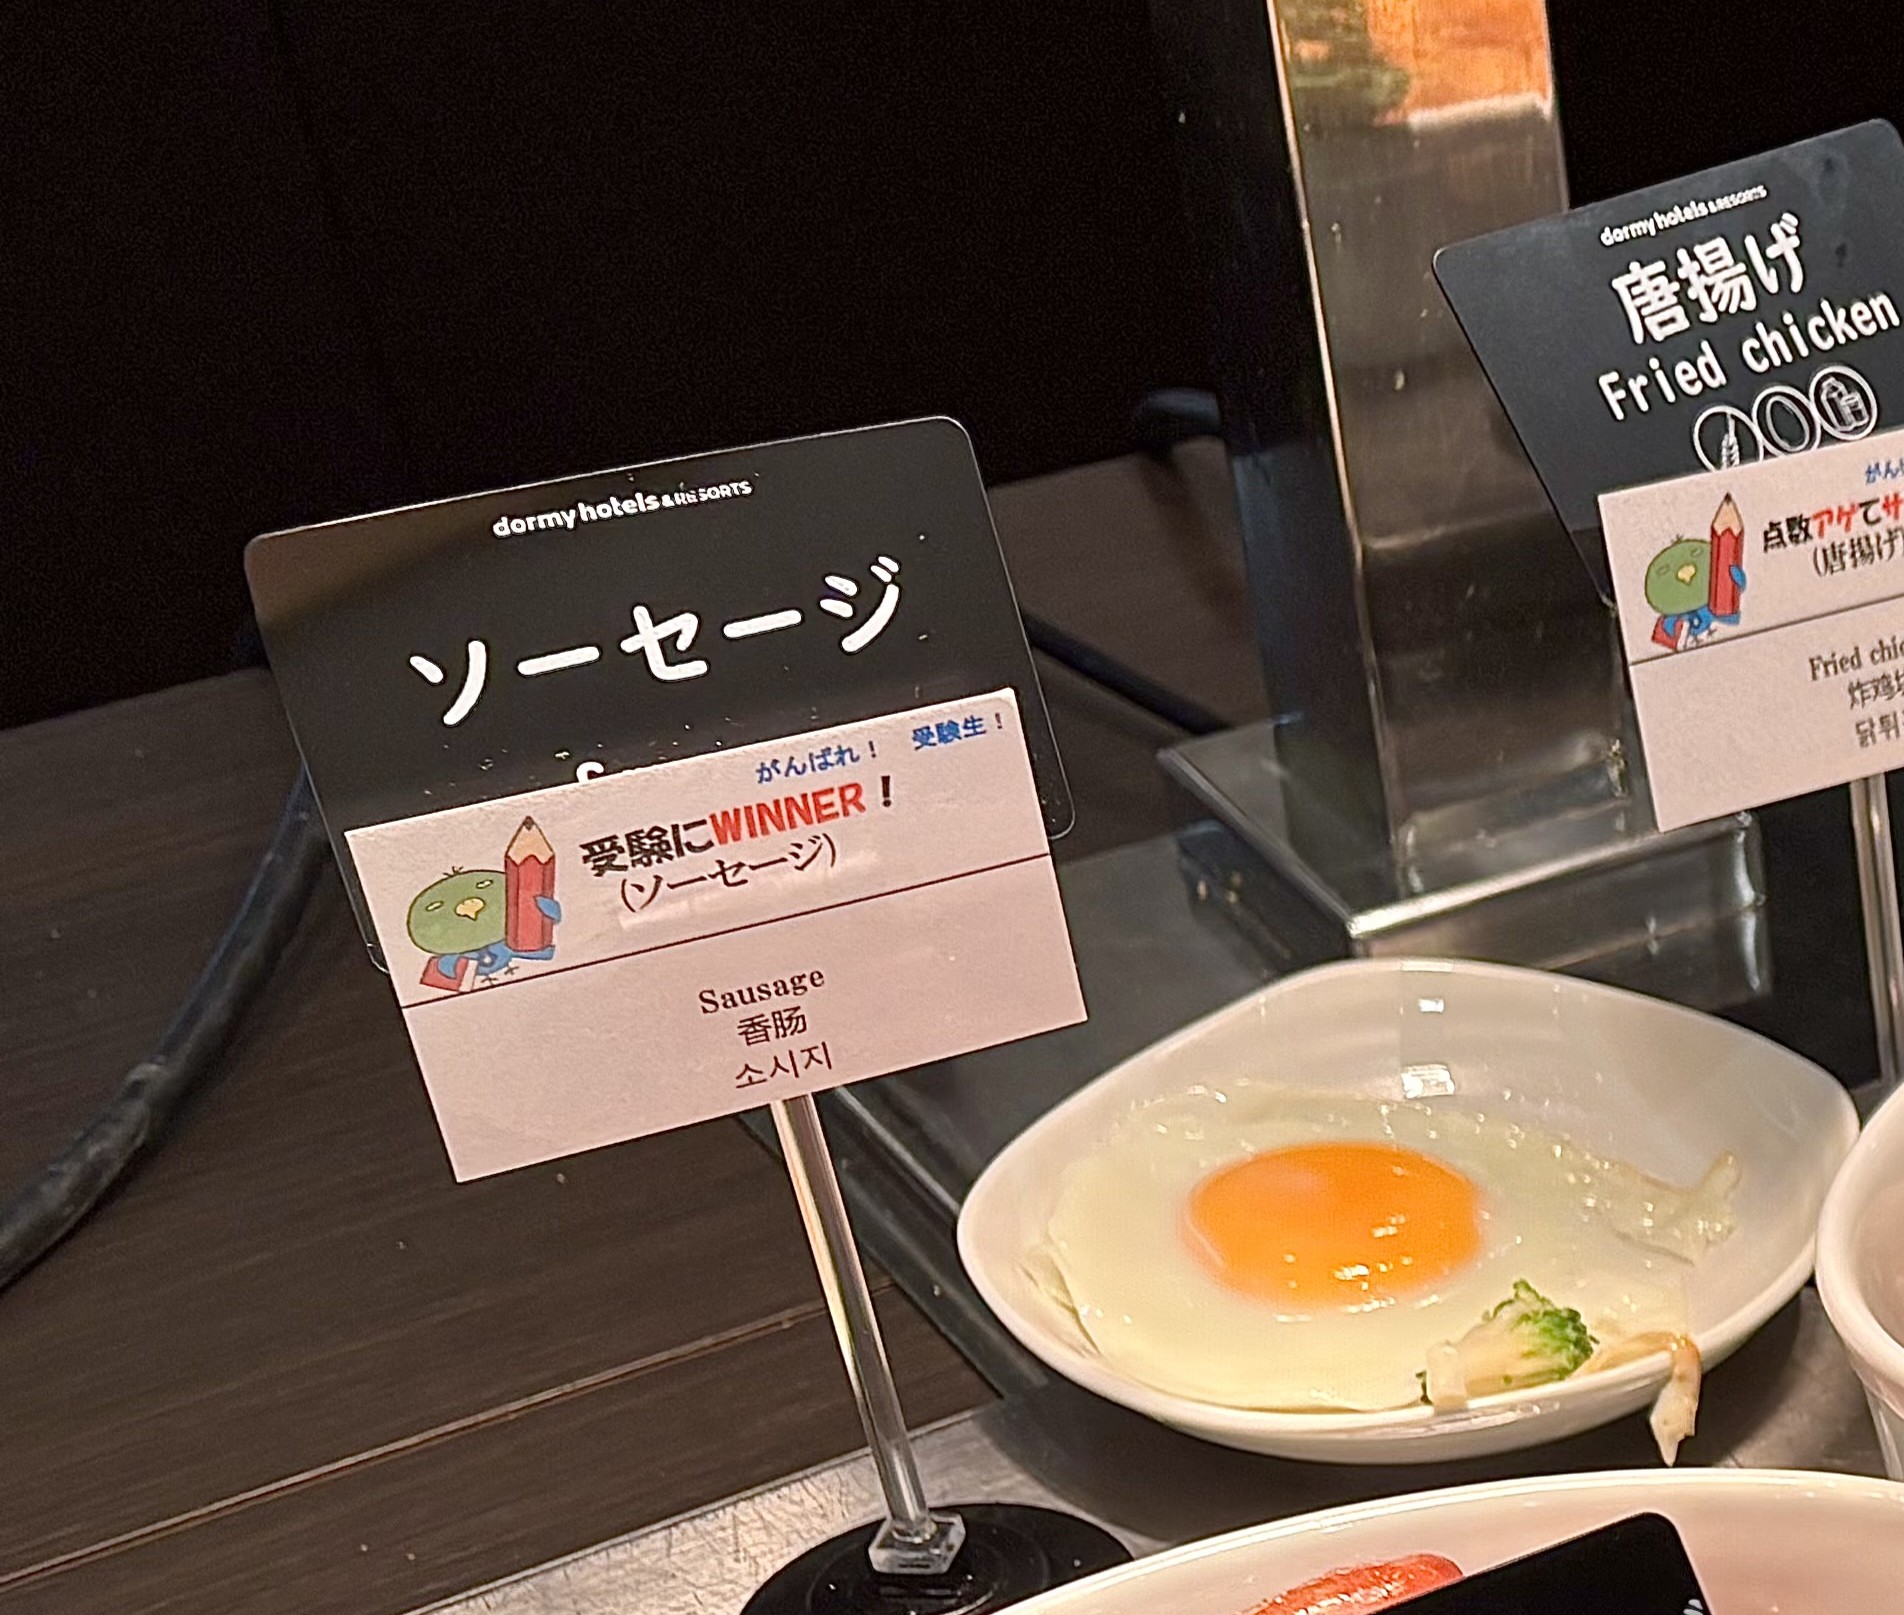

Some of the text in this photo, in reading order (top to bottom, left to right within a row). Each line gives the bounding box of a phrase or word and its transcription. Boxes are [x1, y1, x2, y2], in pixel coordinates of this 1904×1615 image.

[1611, 212, 1805, 345] 唐揚げ
[1598, 292, 1901, 421] Fried chicken
[407, 554, 902, 728] ソーセージ
[1808, 645, 1863, 682] Fried
[756, 712, 1004, 785] がんばれ！ 受験生！
[698, 969, 826, 1015] Sausage
[736, 1005, 808, 1047] 香肠
[735, 1040, 833, 1090] 소시지
